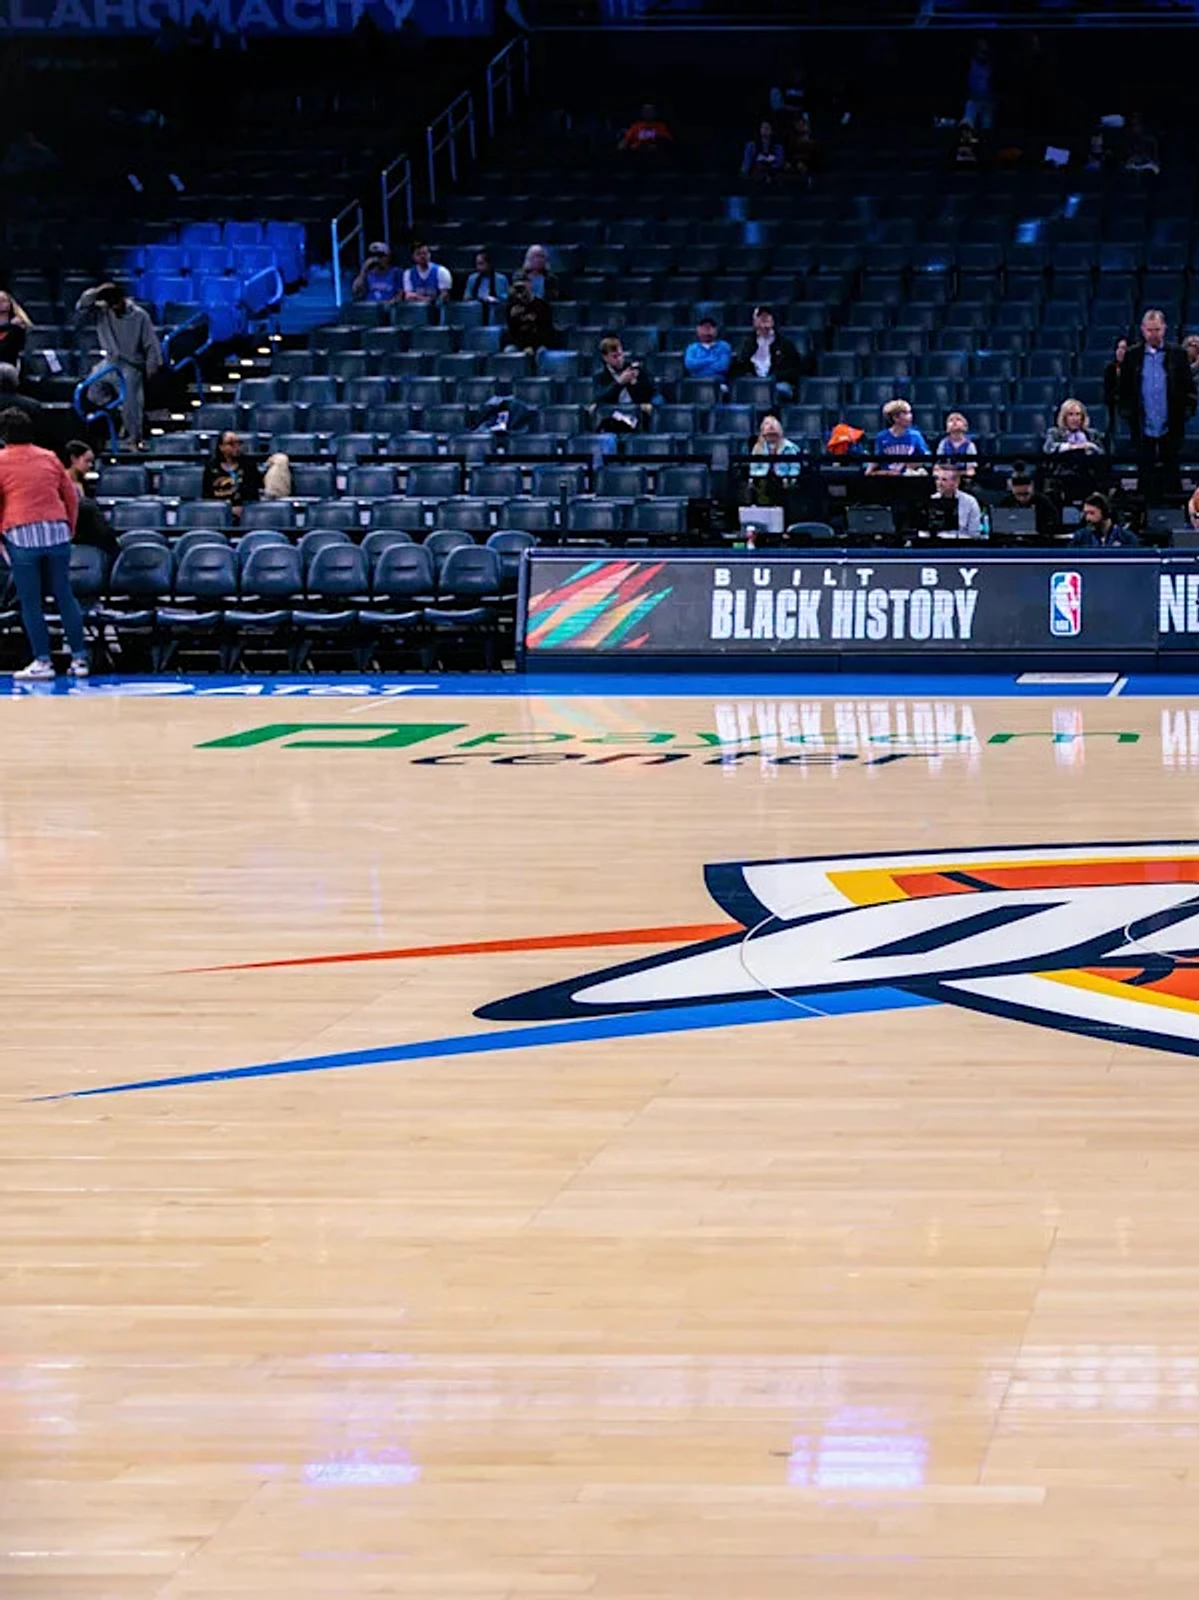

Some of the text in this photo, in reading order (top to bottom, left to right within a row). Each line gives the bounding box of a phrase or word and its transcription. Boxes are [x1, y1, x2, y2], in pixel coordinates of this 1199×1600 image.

[0, 0, 279, 29] LAHOMA
[714, 568, 979, 586] BUILT BY
[711, 589, 978, 639] BLACK HISTORY
[455, 732, 1140, 748] paycom
[411, 751, 940, 765] center
